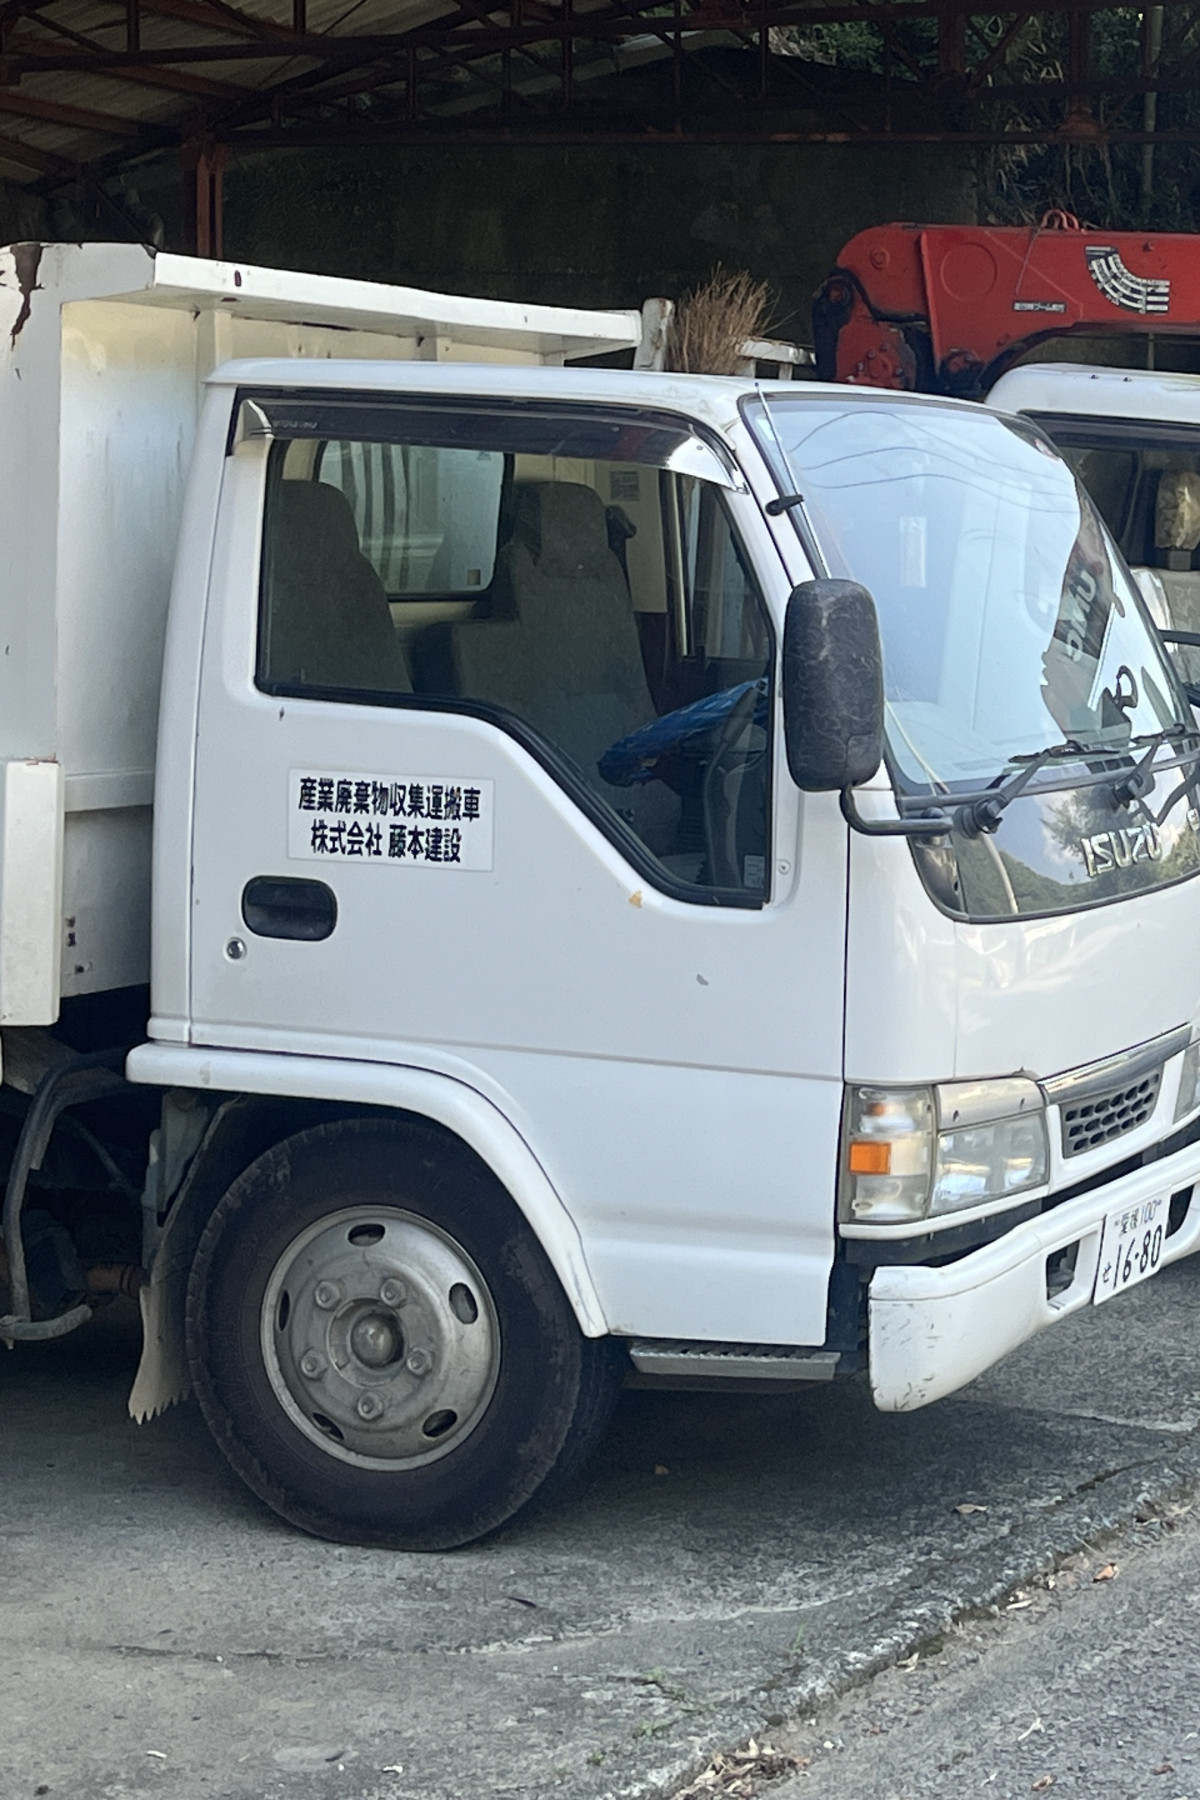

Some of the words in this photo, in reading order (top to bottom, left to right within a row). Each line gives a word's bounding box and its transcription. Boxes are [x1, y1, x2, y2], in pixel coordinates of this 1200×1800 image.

[299, 777, 481, 823] 産業廃棄物収集運搬車
[311, 818, 383, 856] 株式会社
[388, 824, 463, 864] 藤本建設
[1081, 821, 1163, 878] ISUZU
[1113, 1224, 1162, 1289] 16-80
